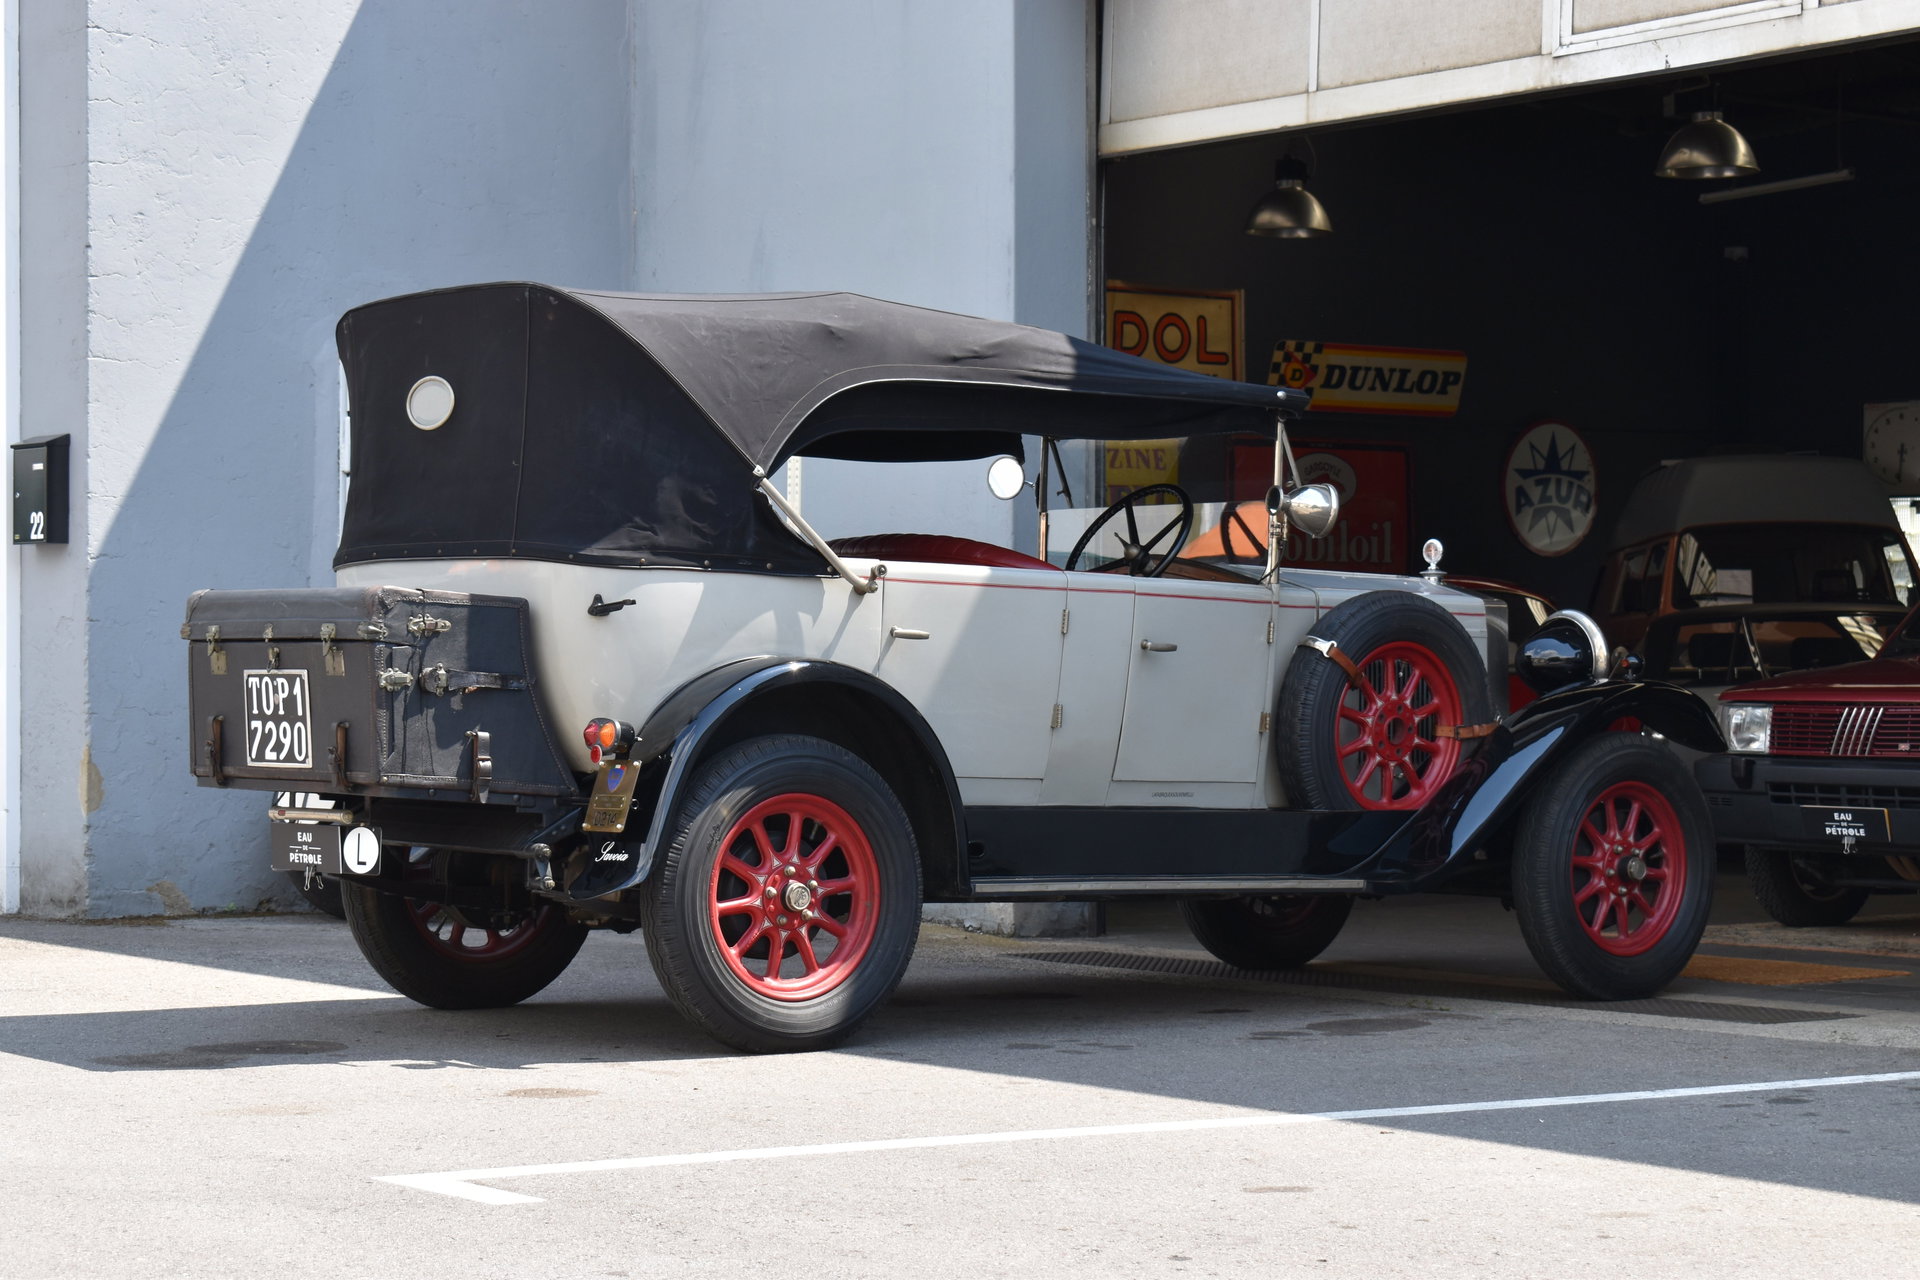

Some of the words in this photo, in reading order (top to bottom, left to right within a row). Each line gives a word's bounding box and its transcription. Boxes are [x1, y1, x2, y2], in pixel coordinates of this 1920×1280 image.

[1113, 310, 1230, 365] DOL
[1320, 364, 1462, 396] DUNLOP
[1106, 448, 1167, 471] ZINE
[1514, 477, 1593, 518] AZUR
[30, 511, 44, 540] 22
[1285, 519, 1393, 564] obiloil
[250, 720, 306, 761] 7290
[1825, 825, 1866, 836] PÉTROLE
[1833, 812, 1852, 821] EAU
[297, 832, 312, 842] EAU
[357, 832, 367, 865] L
[594, 841, 629, 862] Savoia
[289, 849, 322, 864] PÉTROLE
